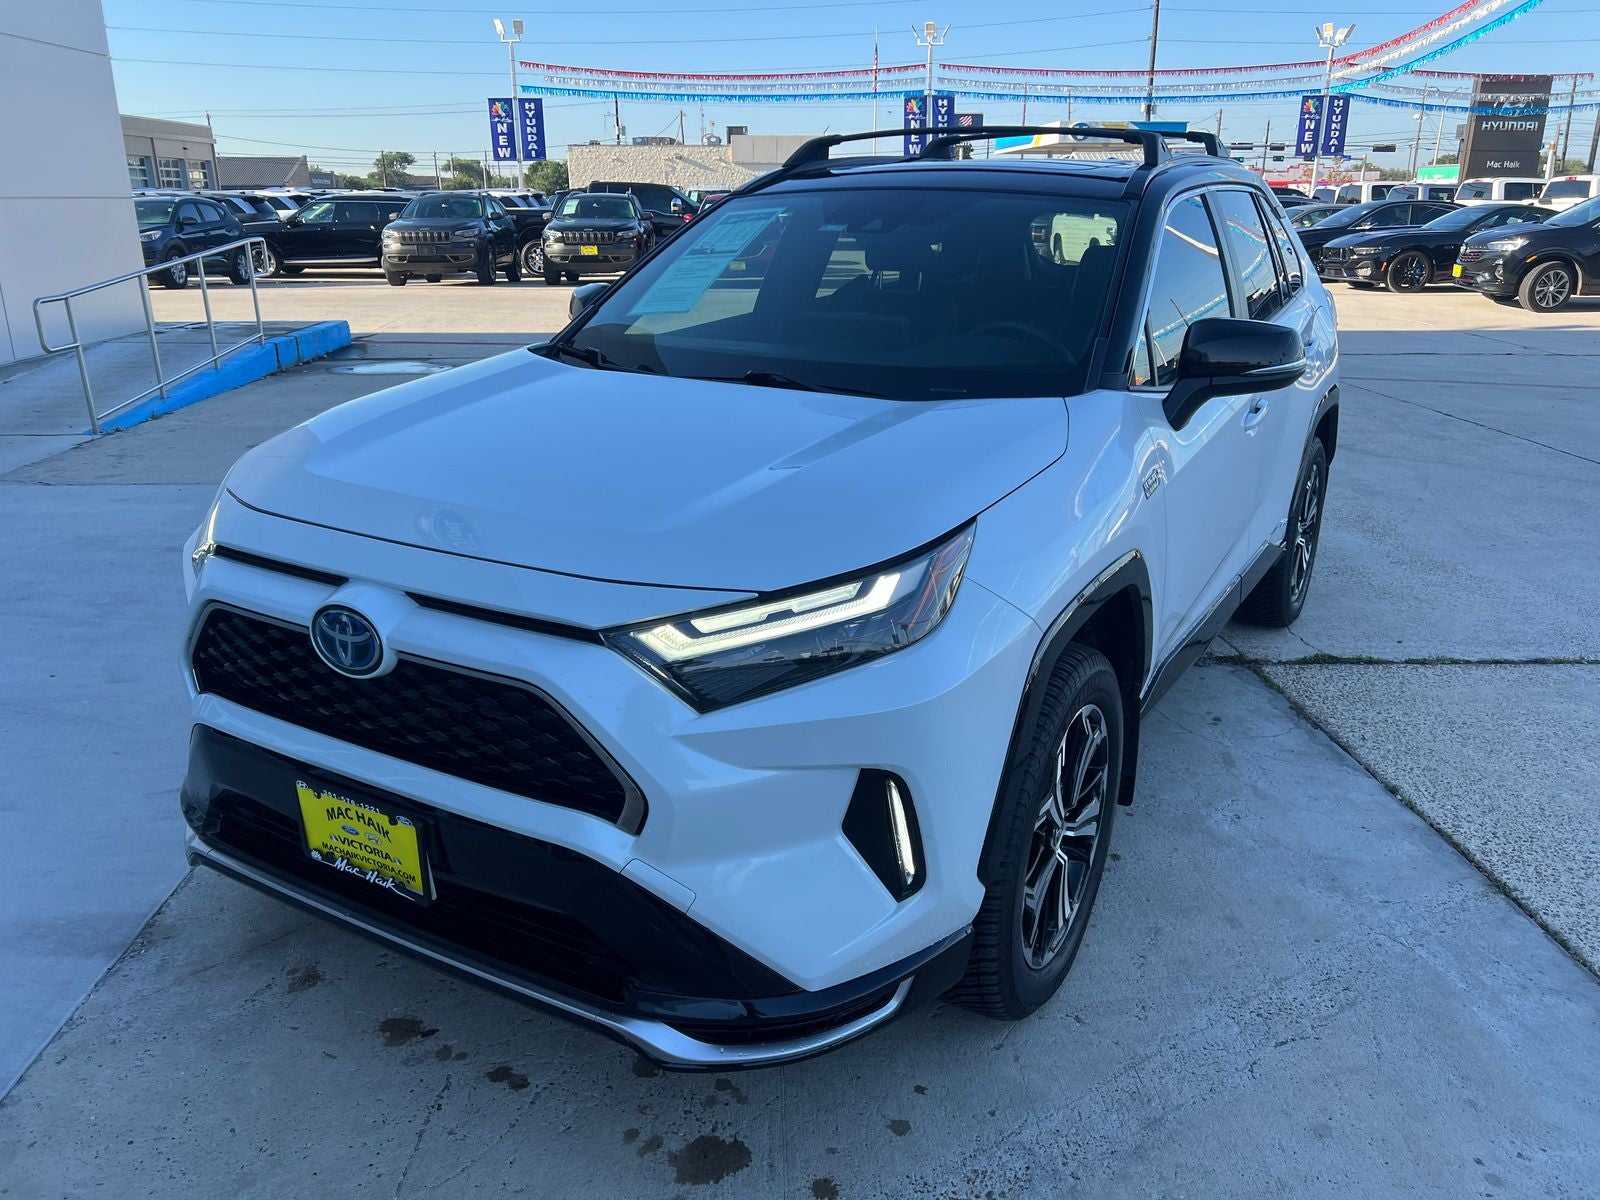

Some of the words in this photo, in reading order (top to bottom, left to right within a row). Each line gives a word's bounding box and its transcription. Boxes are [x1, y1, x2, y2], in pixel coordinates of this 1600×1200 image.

[497, 123, 511, 158] NEW
[524, 102, 538, 158] HYUNDAI
[908, 120, 921, 155] NEW
[1301, 119, 1315, 153] NEW
[1329, 99, 1344, 153] HYUNDAI
[1481, 121, 1539, 131] HYUNDAI
[1486, 160, 1501, 168] Mac
[1503, 160, 1520, 168] Haik
[326, 806, 353, 821] MAC
[355, 810, 392, 844] HAIK
[334, 857, 362, 875] Mac
[338, 835, 393, 863] VICTORIA
